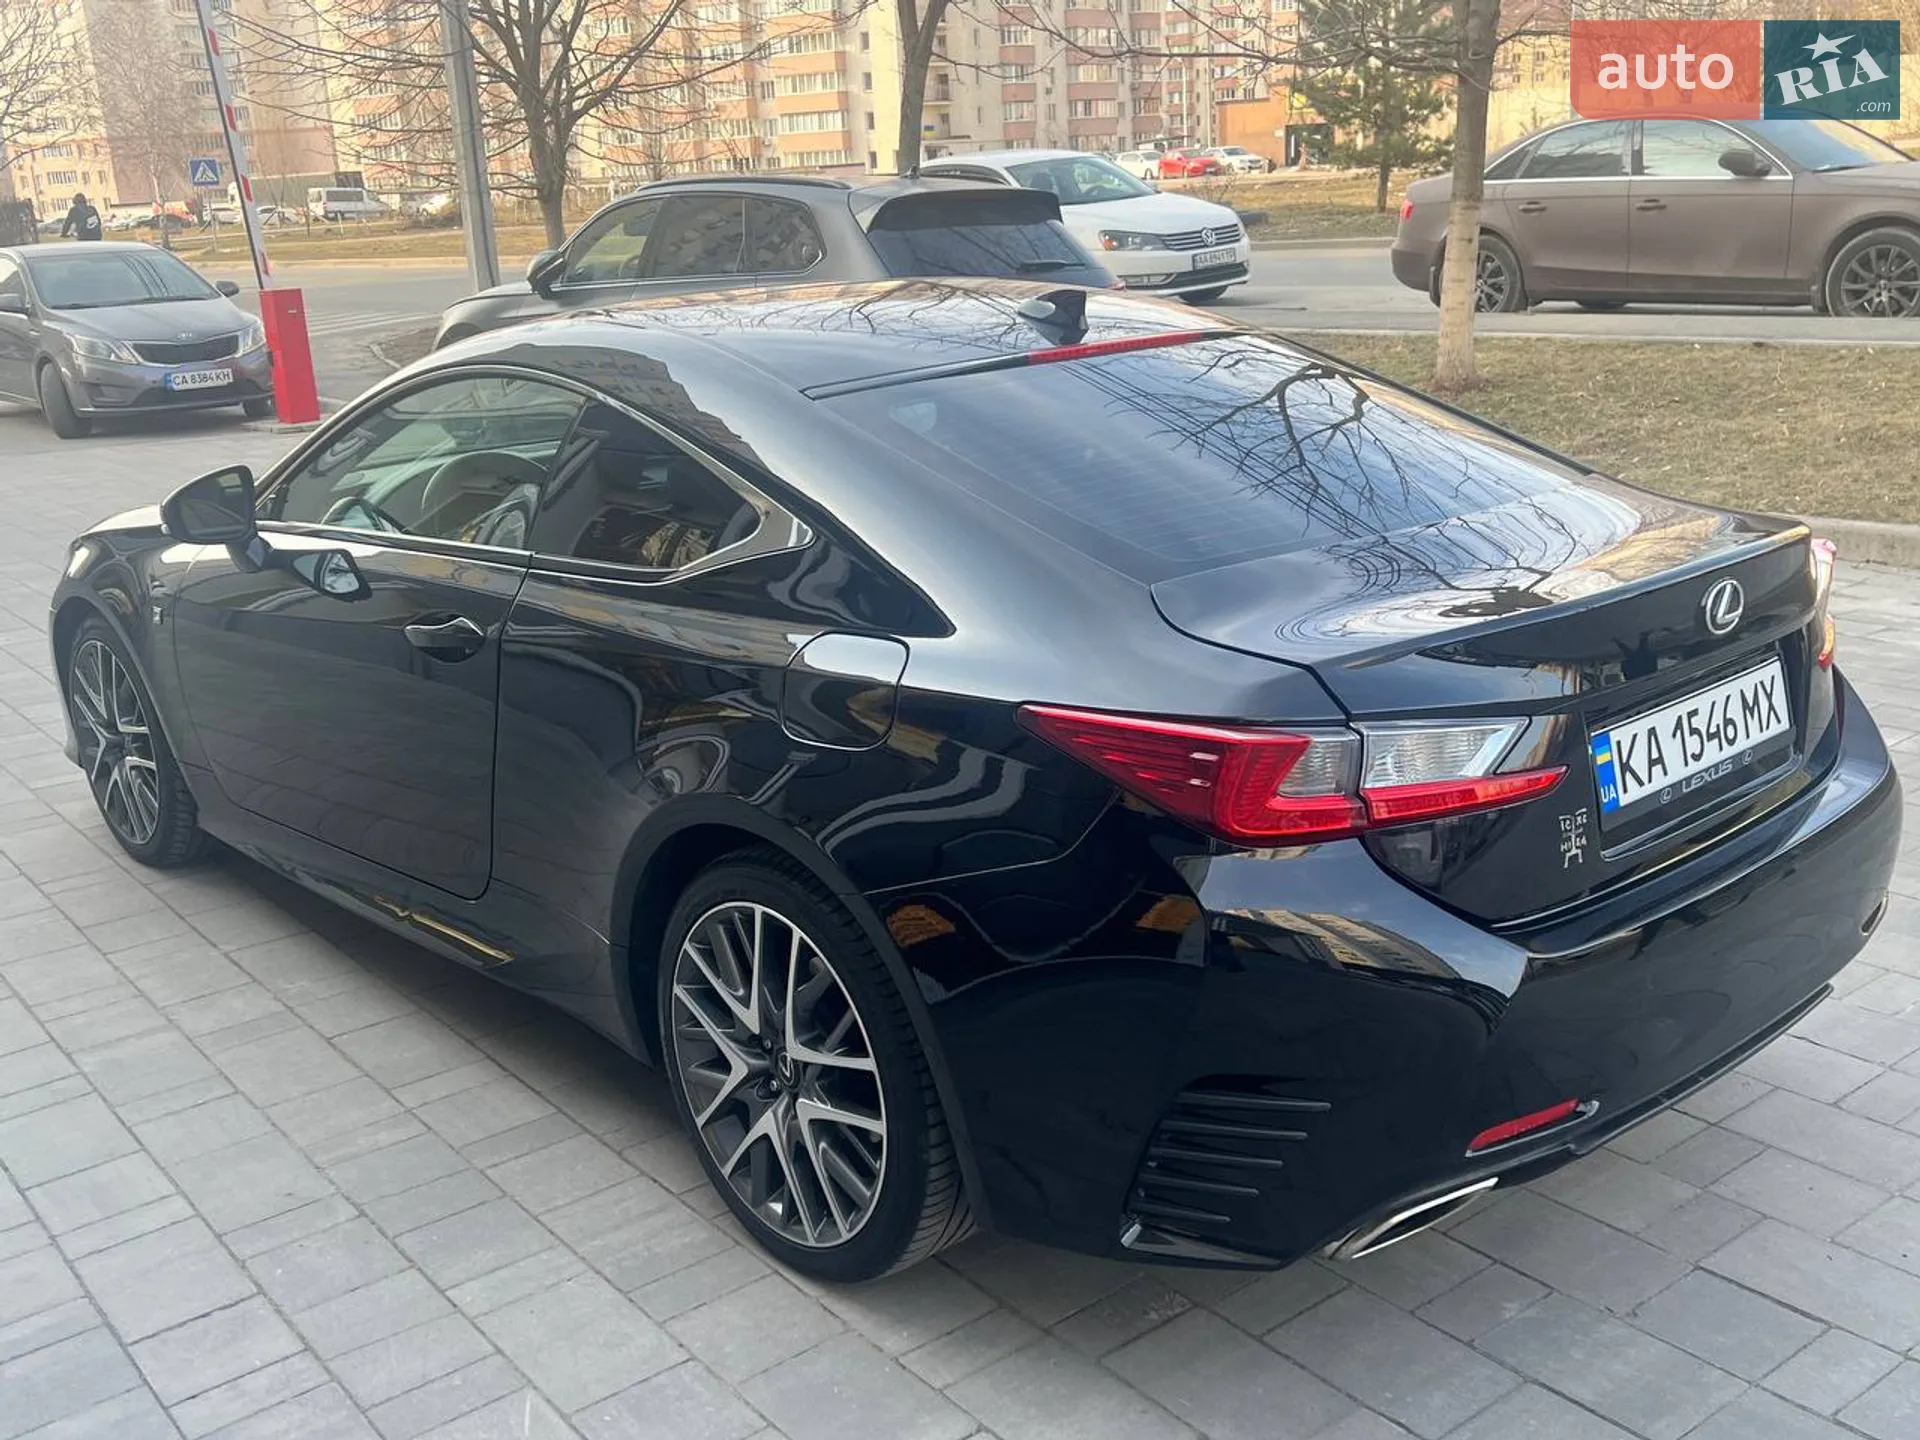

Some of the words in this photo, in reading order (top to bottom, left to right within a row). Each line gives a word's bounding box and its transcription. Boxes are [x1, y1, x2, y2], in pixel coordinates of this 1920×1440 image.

[173, 374, 188, 386] CA
[215, 370, 231, 382] KH
[1616, 726, 1668, 795] KA
[1671, 694, 1738, 768] 1546
[1740, 675, 1782, 740] MX
[1682, 759, 1734, 793] LEXUS
[1600, 783, 1618, 803] UA
